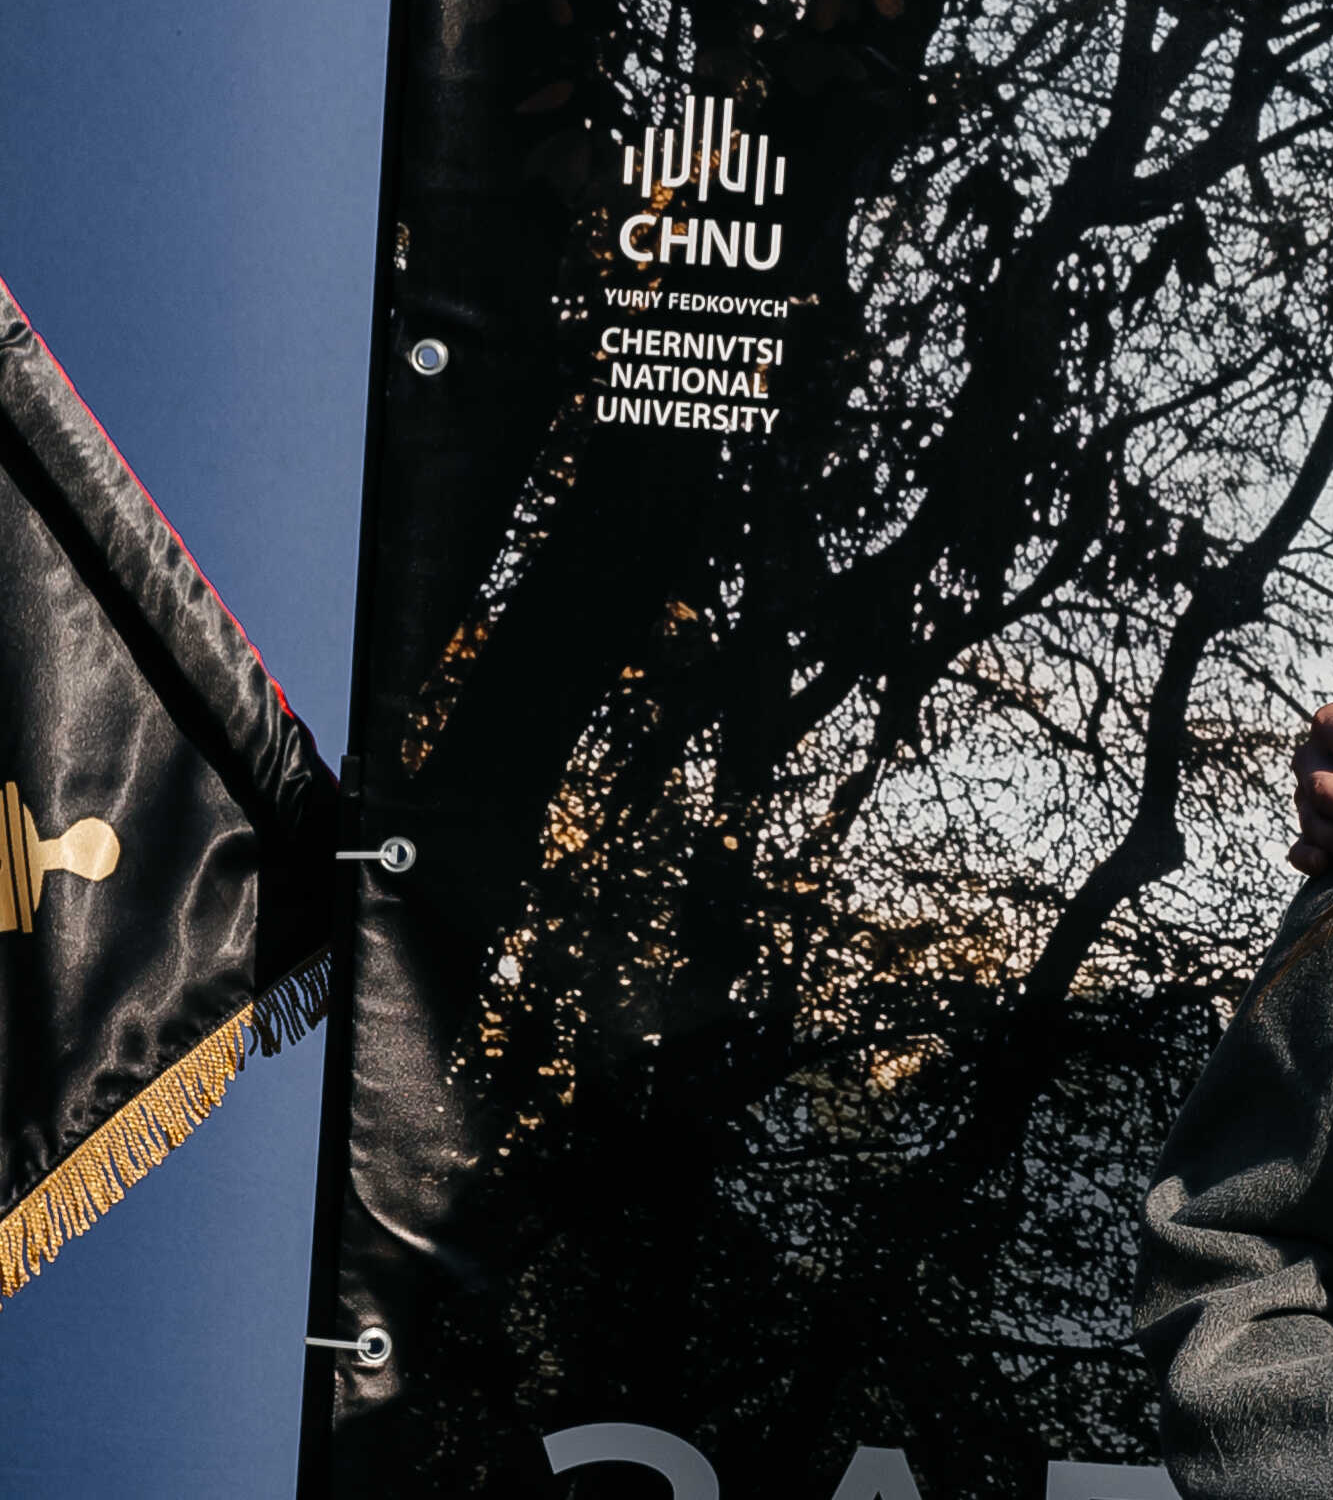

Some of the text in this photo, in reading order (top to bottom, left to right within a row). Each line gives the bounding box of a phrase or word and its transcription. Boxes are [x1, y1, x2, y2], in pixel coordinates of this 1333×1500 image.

[619, 214, 782, 271] CHNU
[604, 288, 788, 318] YURIY FEDKOVYCH
[601, 327, 783, 365] CHERNIVTSI
[611, 362, 768, 399] NATIONAL
[597, 396, 780, 434] UNIVERSITY
